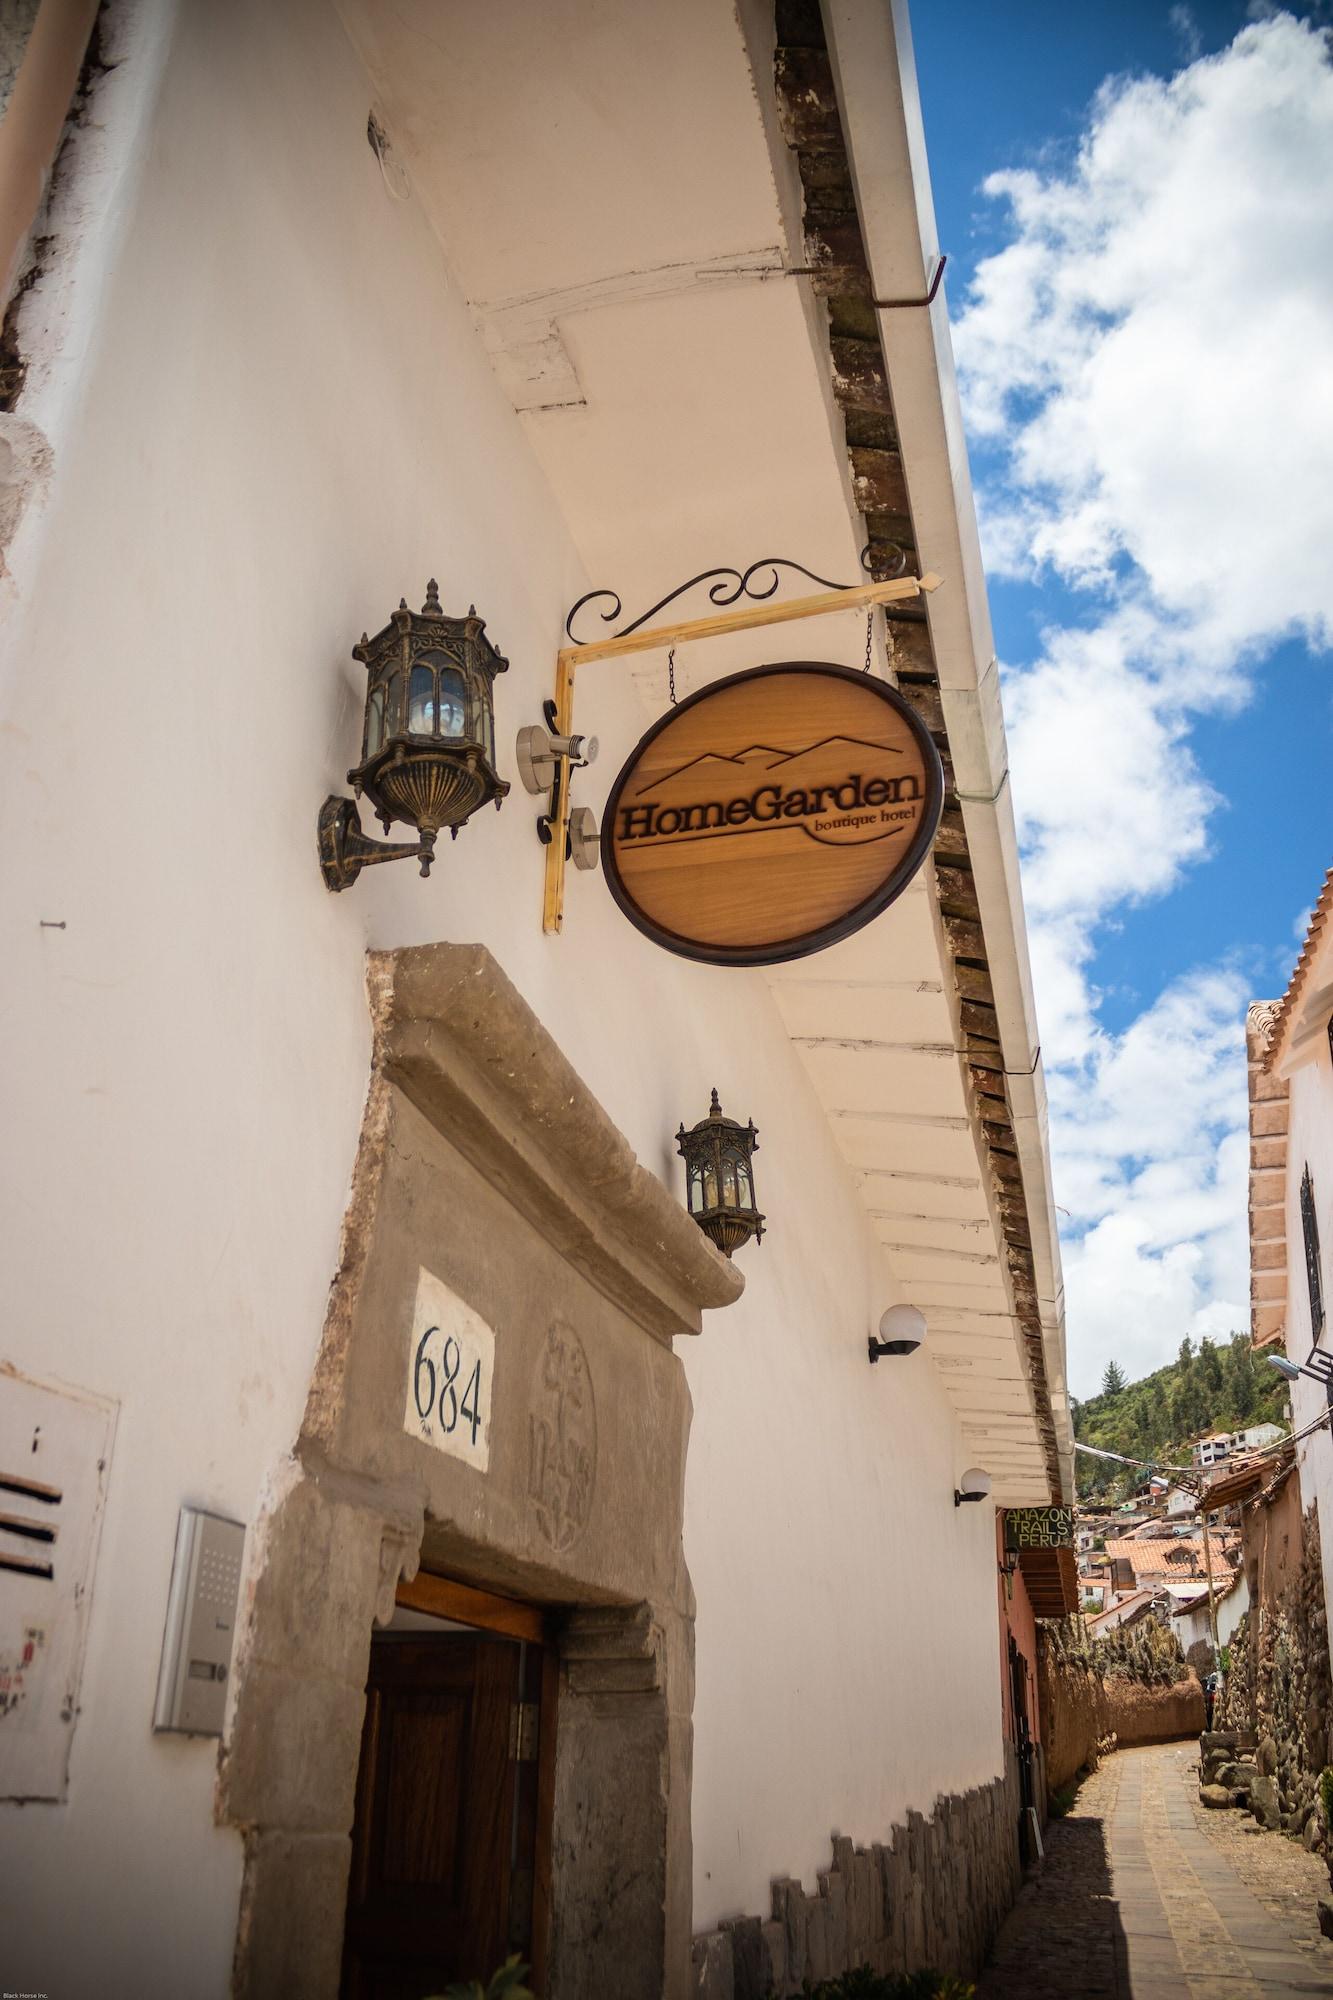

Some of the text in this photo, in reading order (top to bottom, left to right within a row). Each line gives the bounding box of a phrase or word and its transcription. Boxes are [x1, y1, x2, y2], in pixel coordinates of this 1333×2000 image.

[618, 774, 923, 840] HomeGarden
[814, 806, 916, 833] boutique hotel
[414, 1326, 481, 1445] 684
[1006, 1508, 1072, 1522] AMAZON
[1010, 1520, 1068, 1535] TRAILS
[1020, 1534, 1060, 1547] PERU
